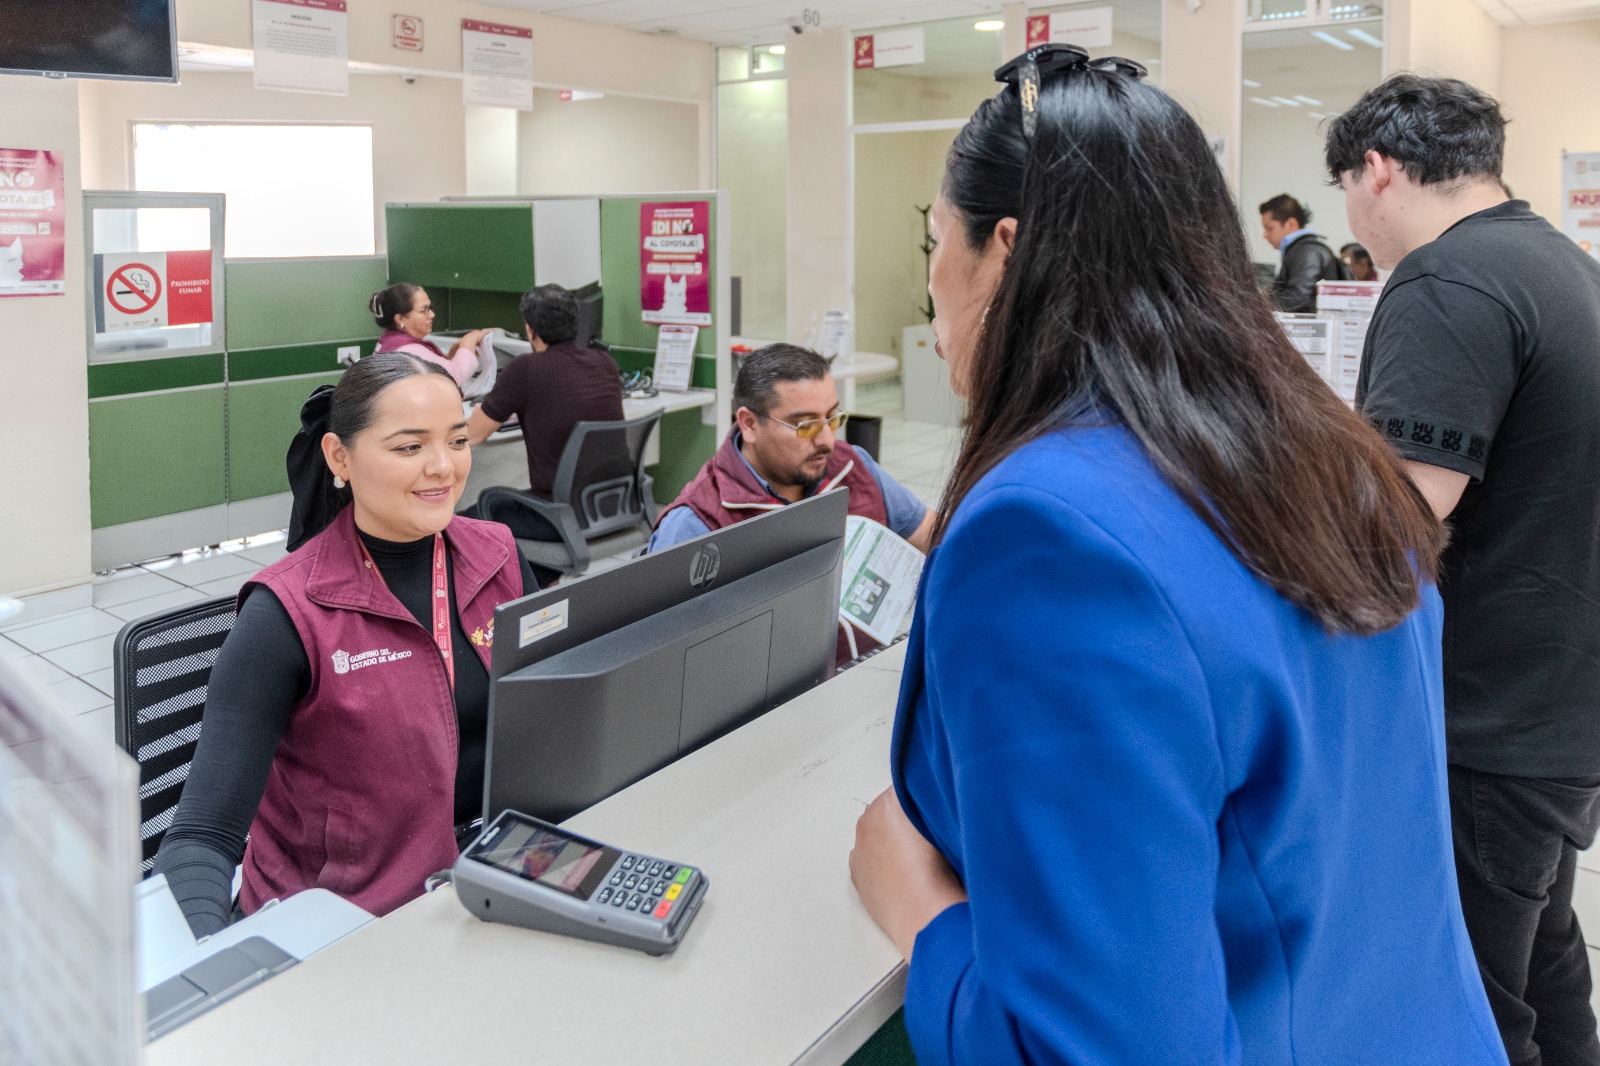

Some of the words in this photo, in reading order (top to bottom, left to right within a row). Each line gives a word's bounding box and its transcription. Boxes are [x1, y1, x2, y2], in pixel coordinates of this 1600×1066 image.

[802, 8, 820, 26] 60
[0, 171, 35, 188] NO
[1573, 194, 1600, 205] NU
[671, 219, 694, 235] NO
[170, 278, 210, 288] PROHIBIDO
[179, 287, 203, 295] FUMAR
[691, 543, 720, 589] hp
[349, 649, 380, 663] GOBIERNO
[380, 648, 391, 656] DEL
[350, 657, 377, 671] ESTADO
[378, 655, 387, 663] DE
[387, 650, 412, 662] MÉXICO
